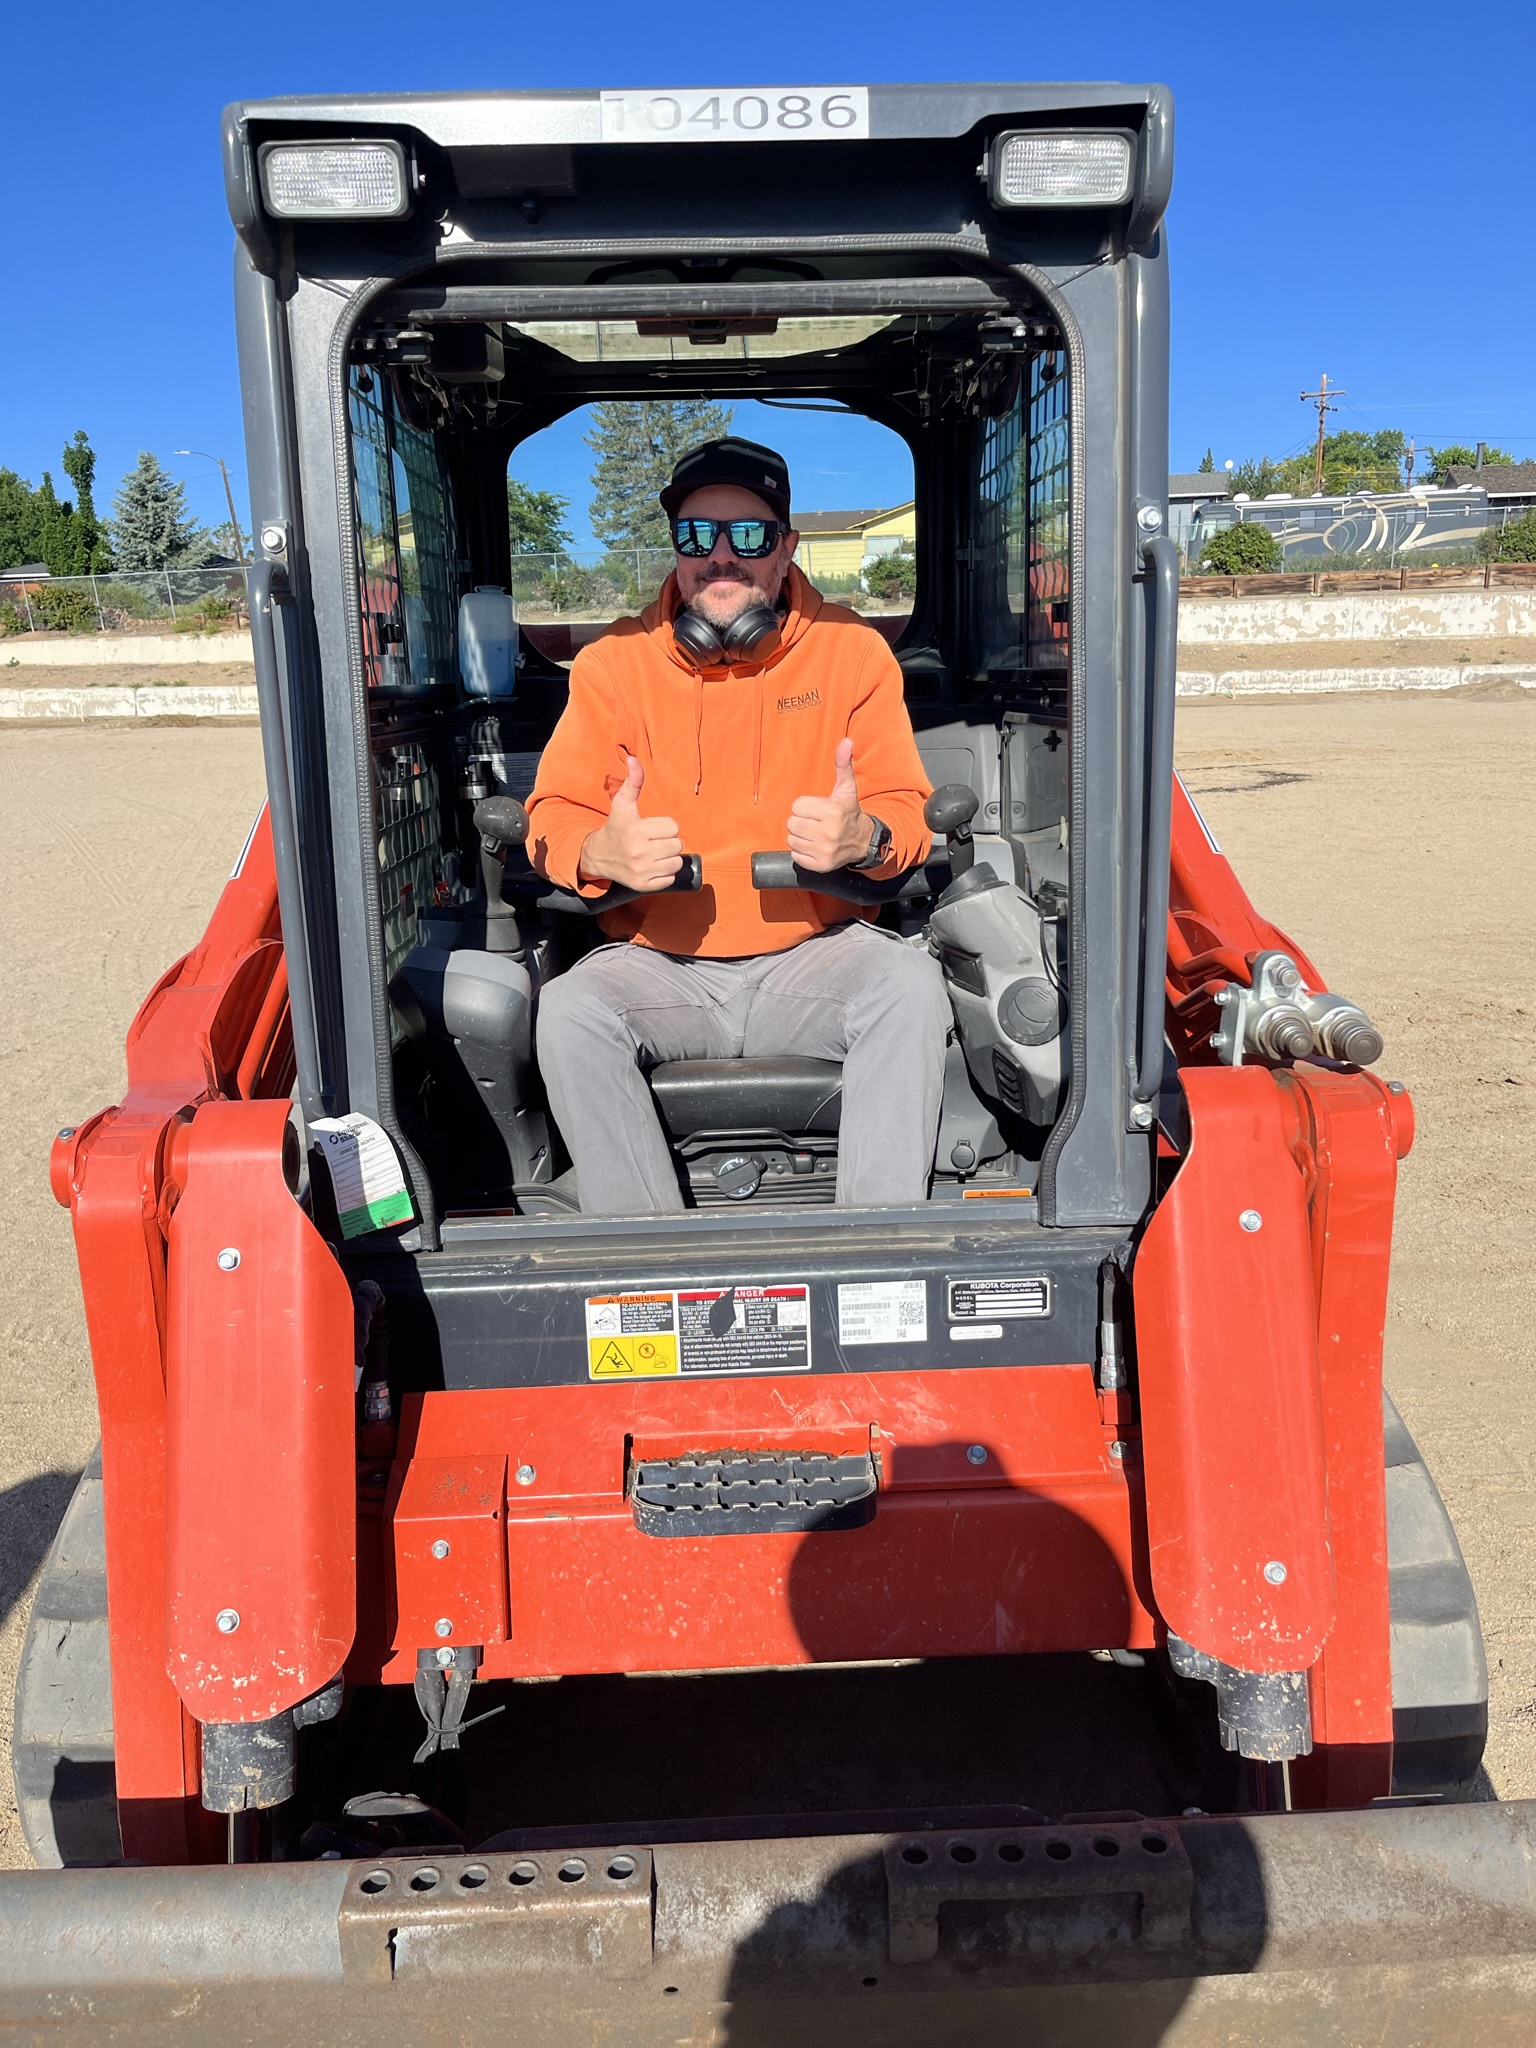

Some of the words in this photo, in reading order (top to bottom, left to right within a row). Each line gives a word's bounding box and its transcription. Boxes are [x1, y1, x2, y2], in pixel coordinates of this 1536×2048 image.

[604, 94, 857, 132] 104086
[777, 688, 819, 710] NEENAN
[970, 1282, 1000, 1290] KUBOTA
[1000, 1280, 1040, 1289] Corporation
[616, 1295, 656, 1303] WARNING
[734, 1290, 765, 1298] ANGER
